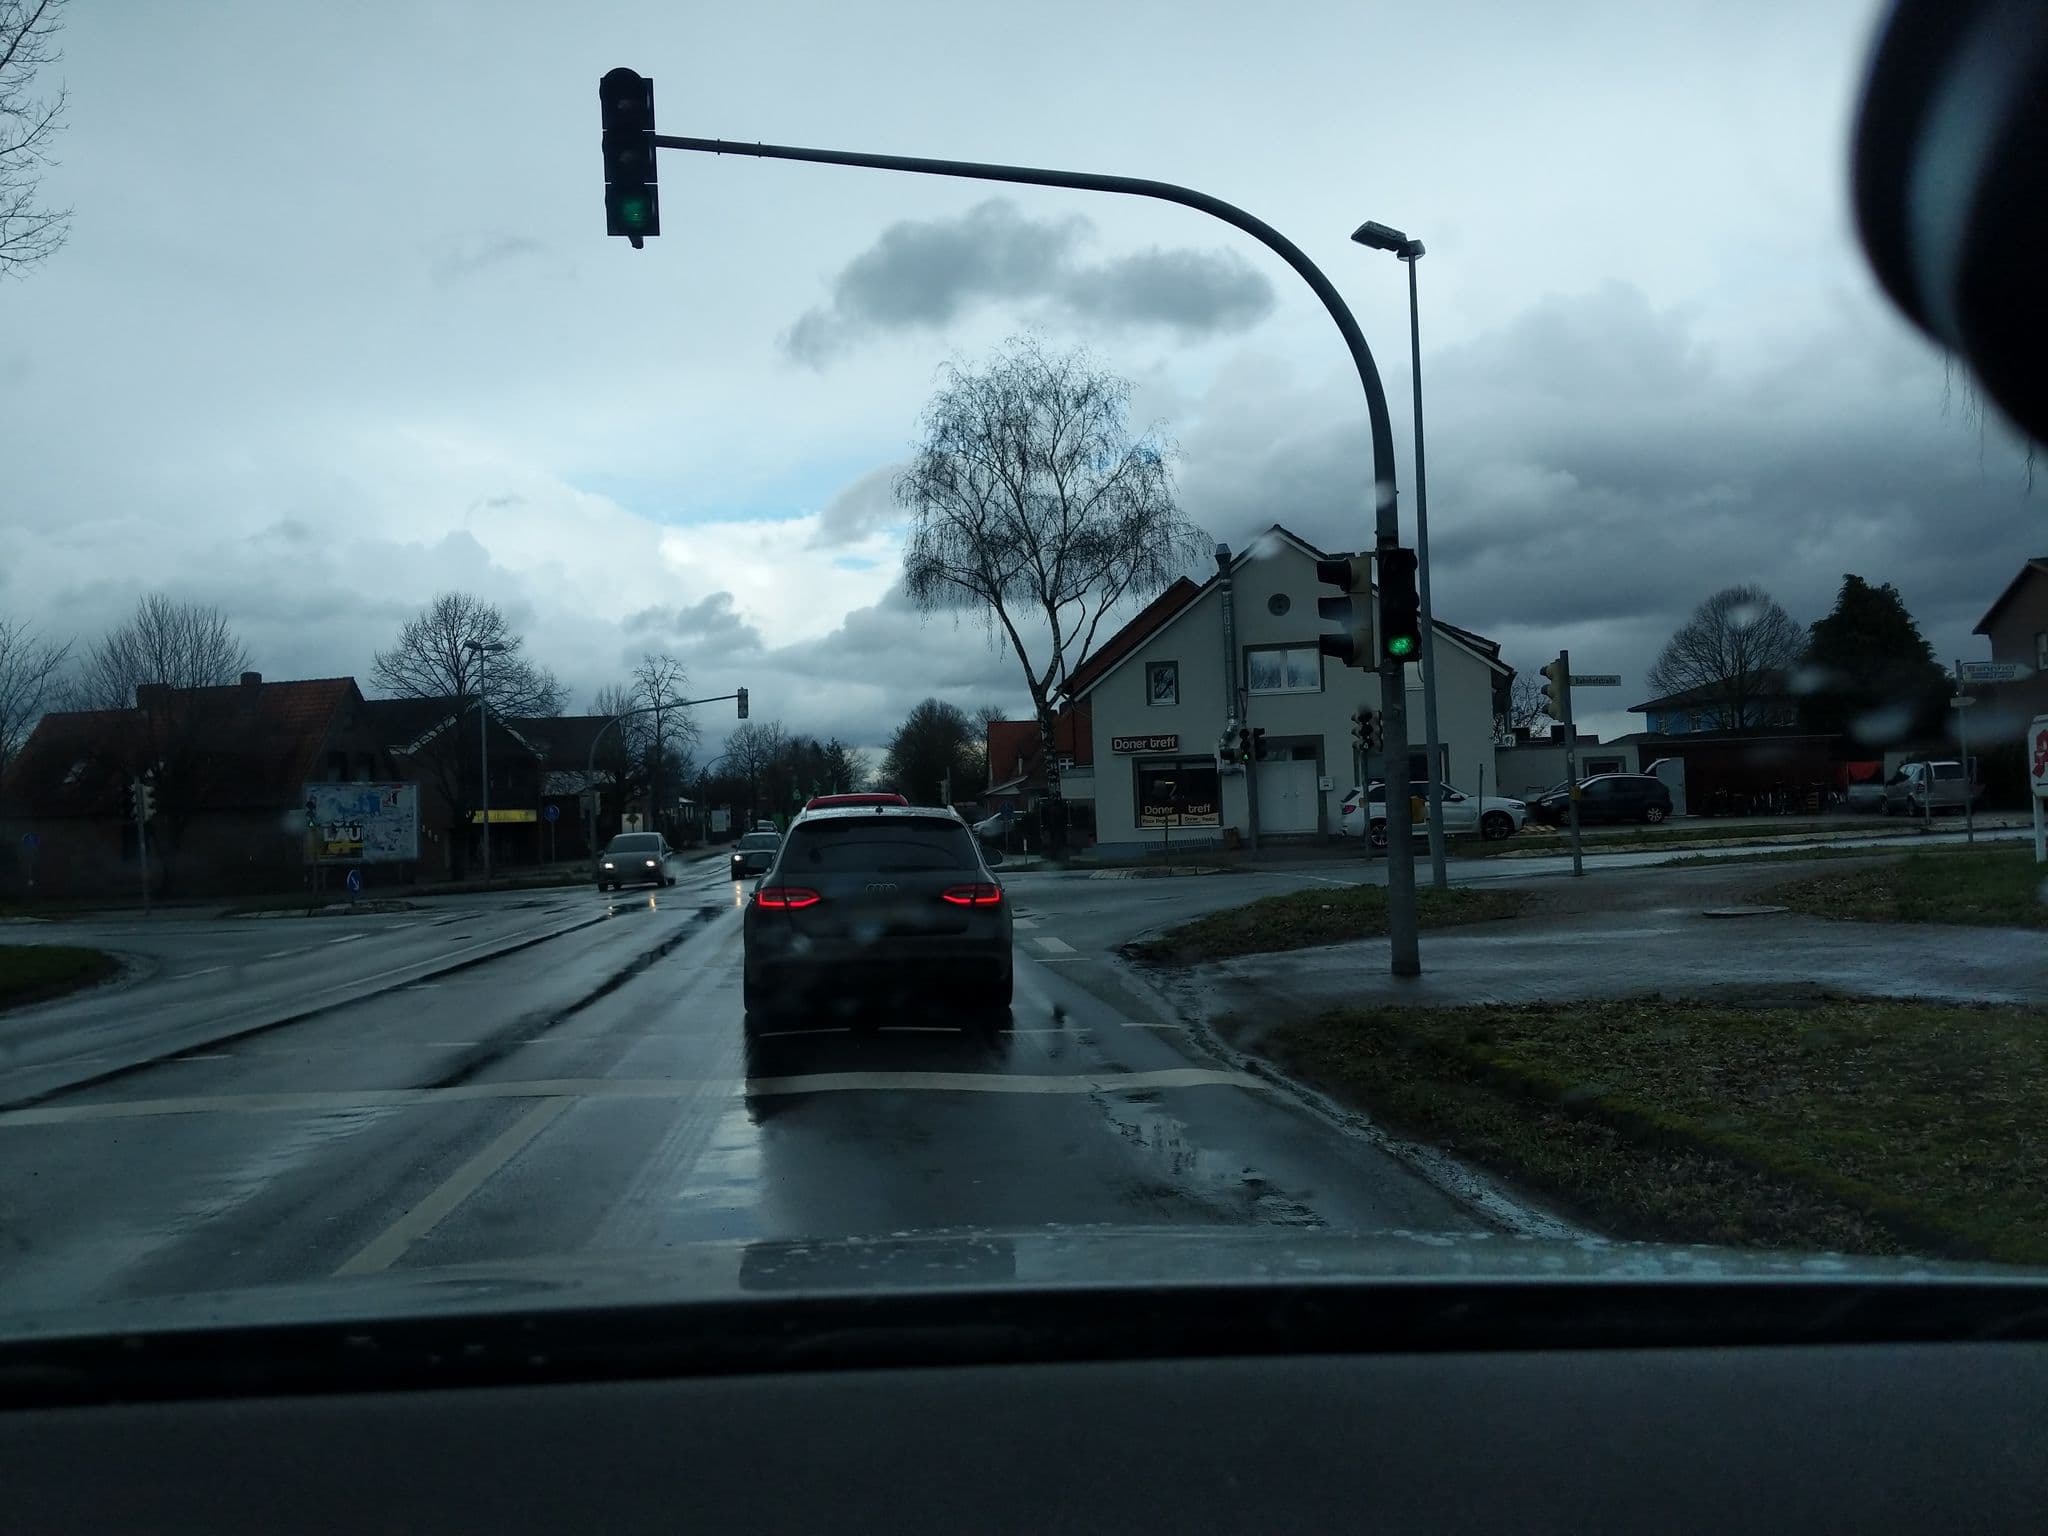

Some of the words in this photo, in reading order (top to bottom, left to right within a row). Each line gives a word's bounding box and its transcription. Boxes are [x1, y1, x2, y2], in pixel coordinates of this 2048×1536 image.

[1114, 738, 1148, 750] Döner
[1150, 736, 1176, 748] treff
[1188, 803, 1210, 814] treff
